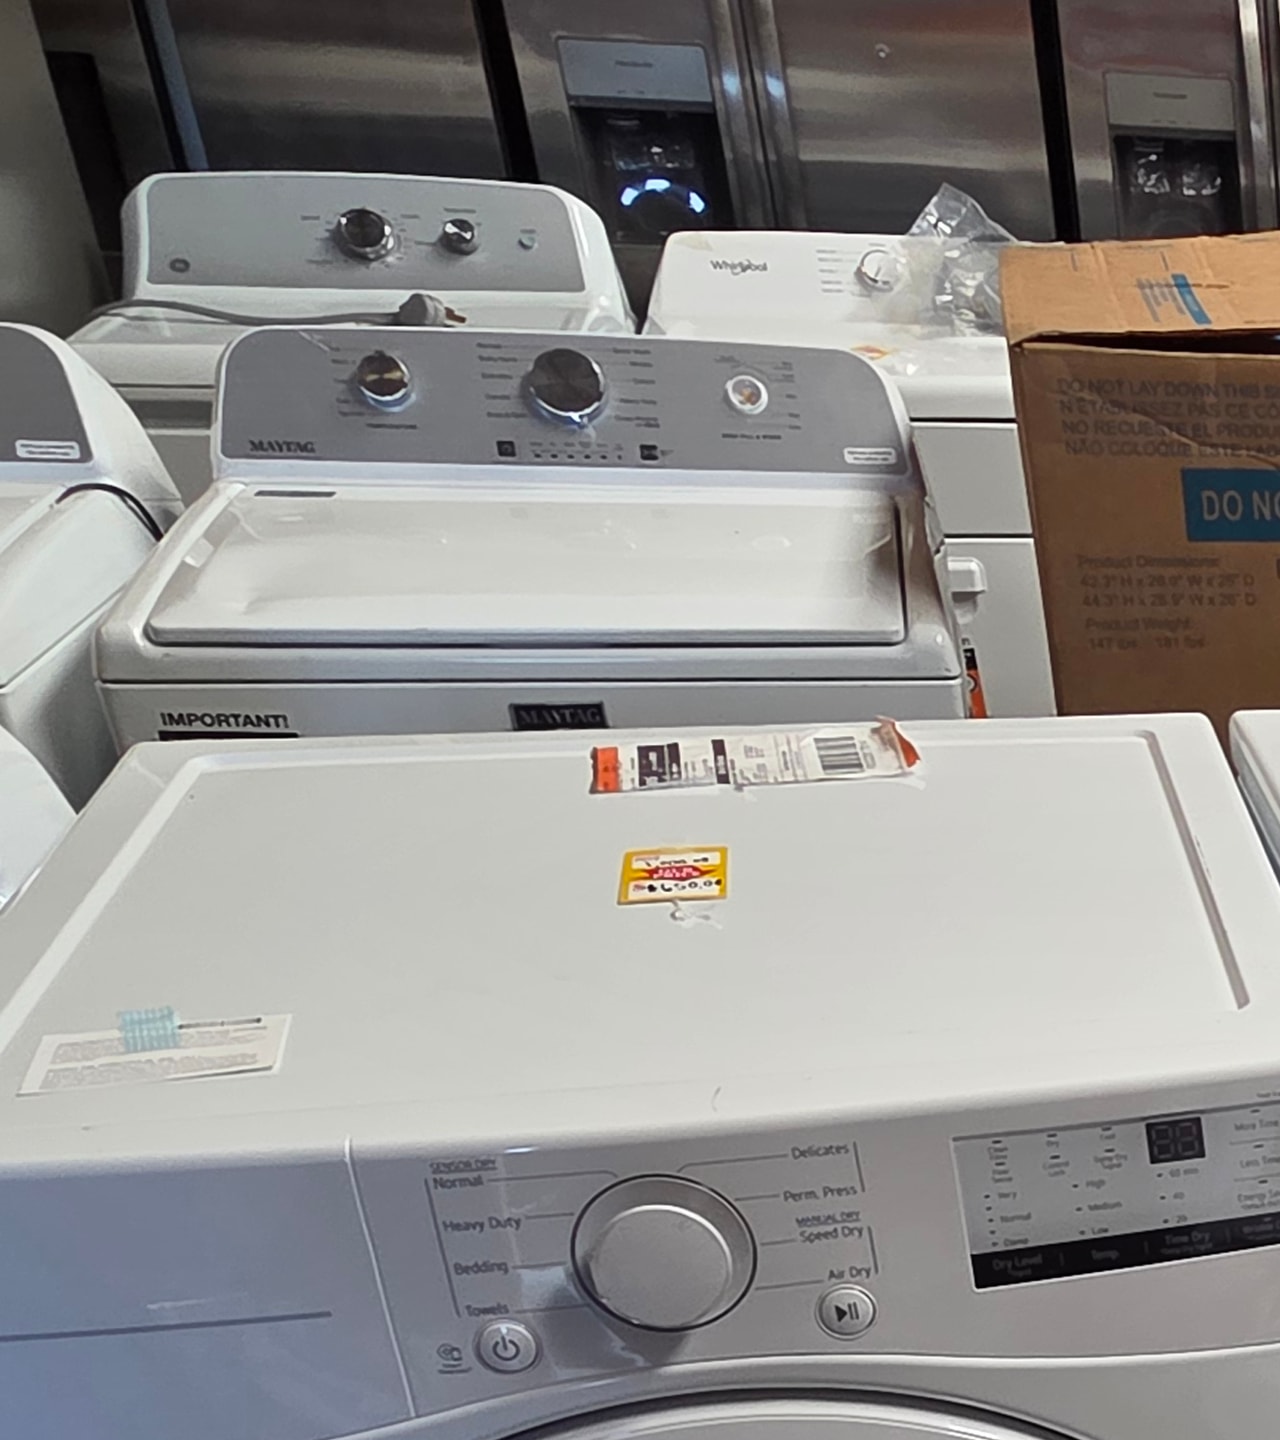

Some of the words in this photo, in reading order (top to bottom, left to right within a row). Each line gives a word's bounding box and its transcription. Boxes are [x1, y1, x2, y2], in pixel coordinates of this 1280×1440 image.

[710, 259, 767, 275] Whirlpool
[1088, 378, 1123, 395] NOT
[1128, 379, 1159, 396] LAY
[1165, 380, 1219, 398] DOWN
[1062, 419, 1089, 434] NO
[248, 440, 316, 454] MAYTAG
[1201, 490, 1243, 521] DO
[160, 711, 290, 729] IMPORTANT!
[518, 706, 601, 725] MAYTAG
[791, 1144, 849, 1160] Delicates
[433, 1174, 484, 1189] Normal
[822, 1185, 858, 1198] Press
[442, 1220, 485, 1233] Heavy
[488, 1216, 522, 1230] Duty
[800, 1227, 839, 1244] Speed
[842, 1226, 863, 1239] Dry
[453, 1261, 509, 1275] Bedding
[828, 1269, 845, 1281] Air
[849, 1266, 871, 1279] Dry
[465, 1303, 509, 1316] Towels
